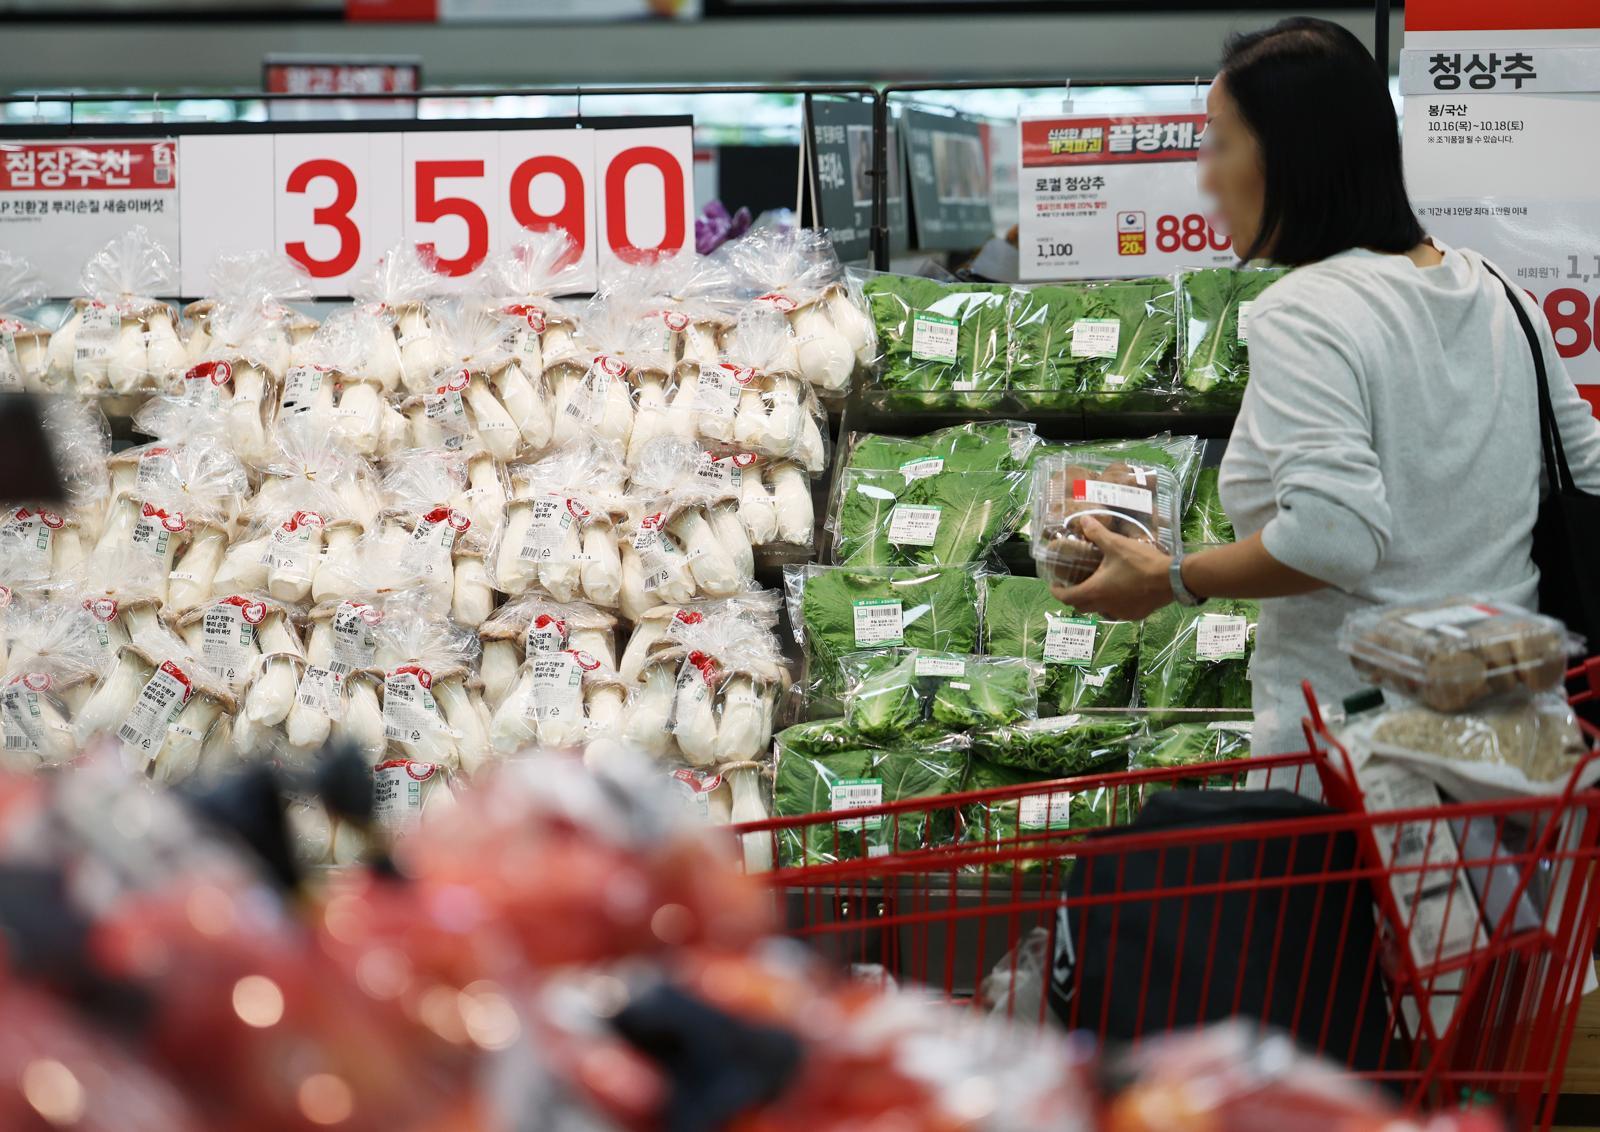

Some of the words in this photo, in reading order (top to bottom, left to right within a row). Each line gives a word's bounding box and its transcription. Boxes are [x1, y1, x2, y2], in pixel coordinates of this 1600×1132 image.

[1428, 52, 1537, 90] 청상추
[1428, 104, 1468, 117] 봉/국산
[6, 148, 132, 187] 점장추천
[1035, 177, 1061, 193] 로컬
[1066, 176, 1106, 191] 청상추
[14, 201, 48, 214] 친환경
[103, 199, 164, 214] 새송이버섯
[1037, 243, 1073, 259] 1,100
[1517, 267, 1560, 279] 비회원가
